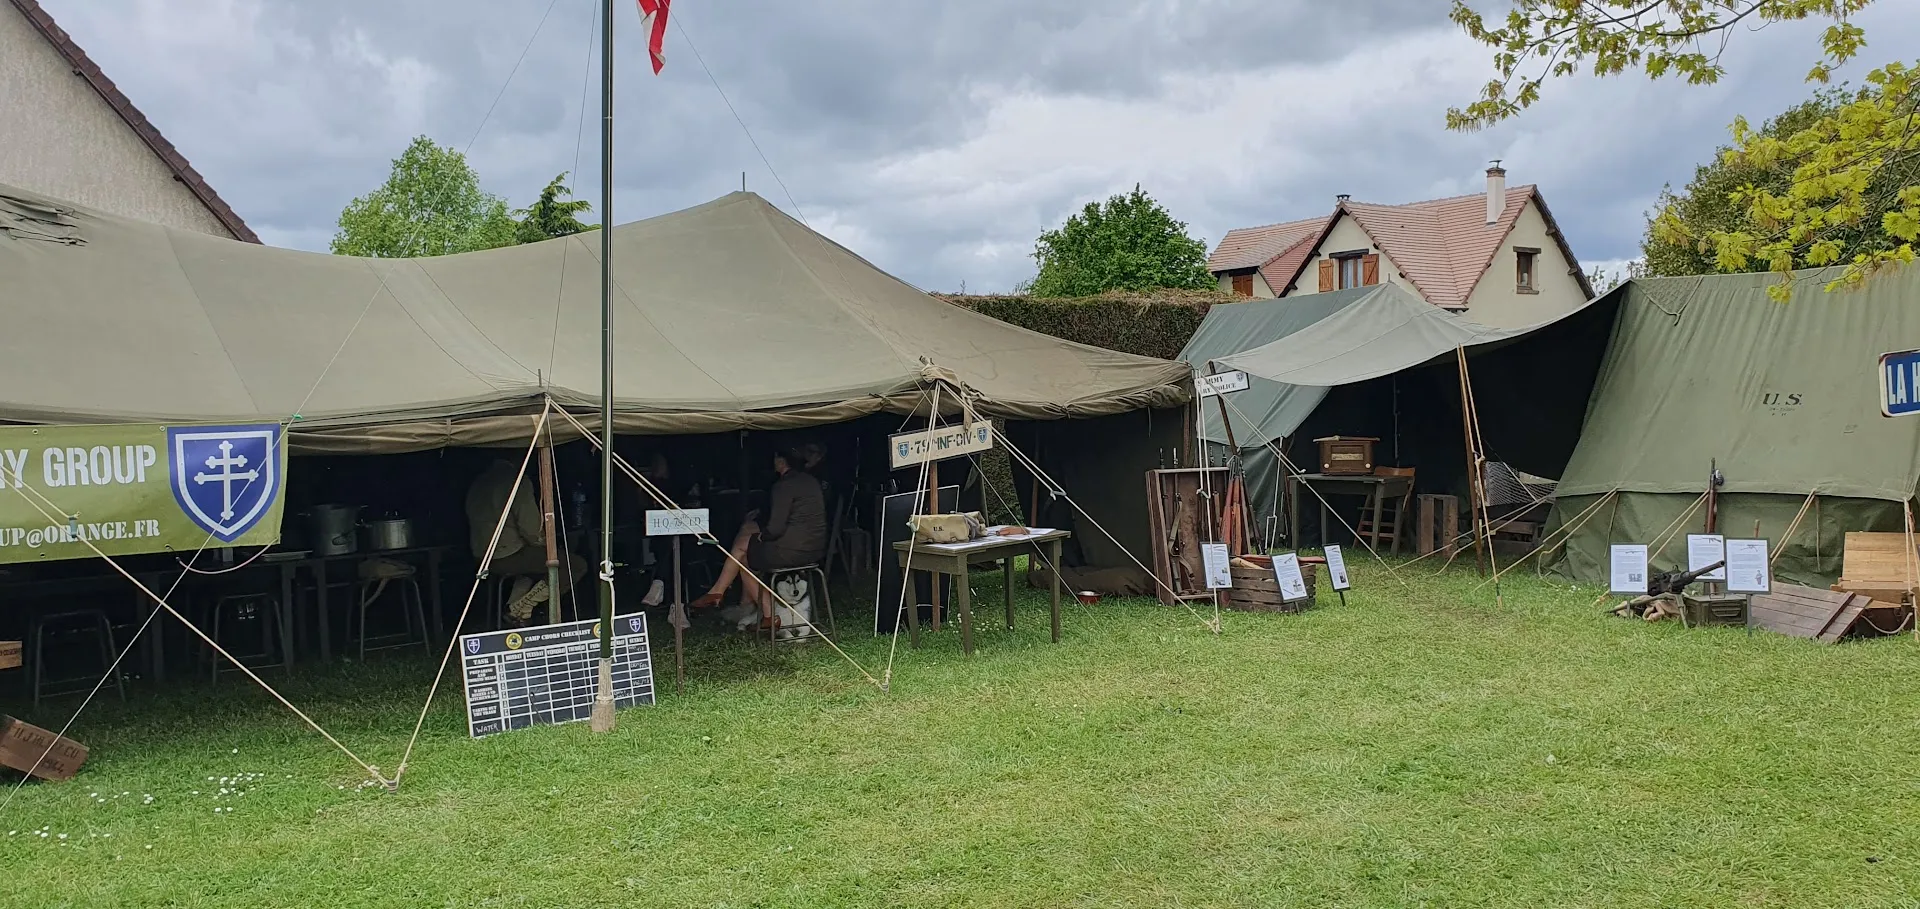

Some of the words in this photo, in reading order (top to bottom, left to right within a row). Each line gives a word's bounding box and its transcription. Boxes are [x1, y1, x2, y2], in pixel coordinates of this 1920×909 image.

[1887, 363, 1907, 405] LA
[0, 448, 29, 489] Y
[43, 444, 156, 487] GROUP
[476, 723, 500, 734] WATER
